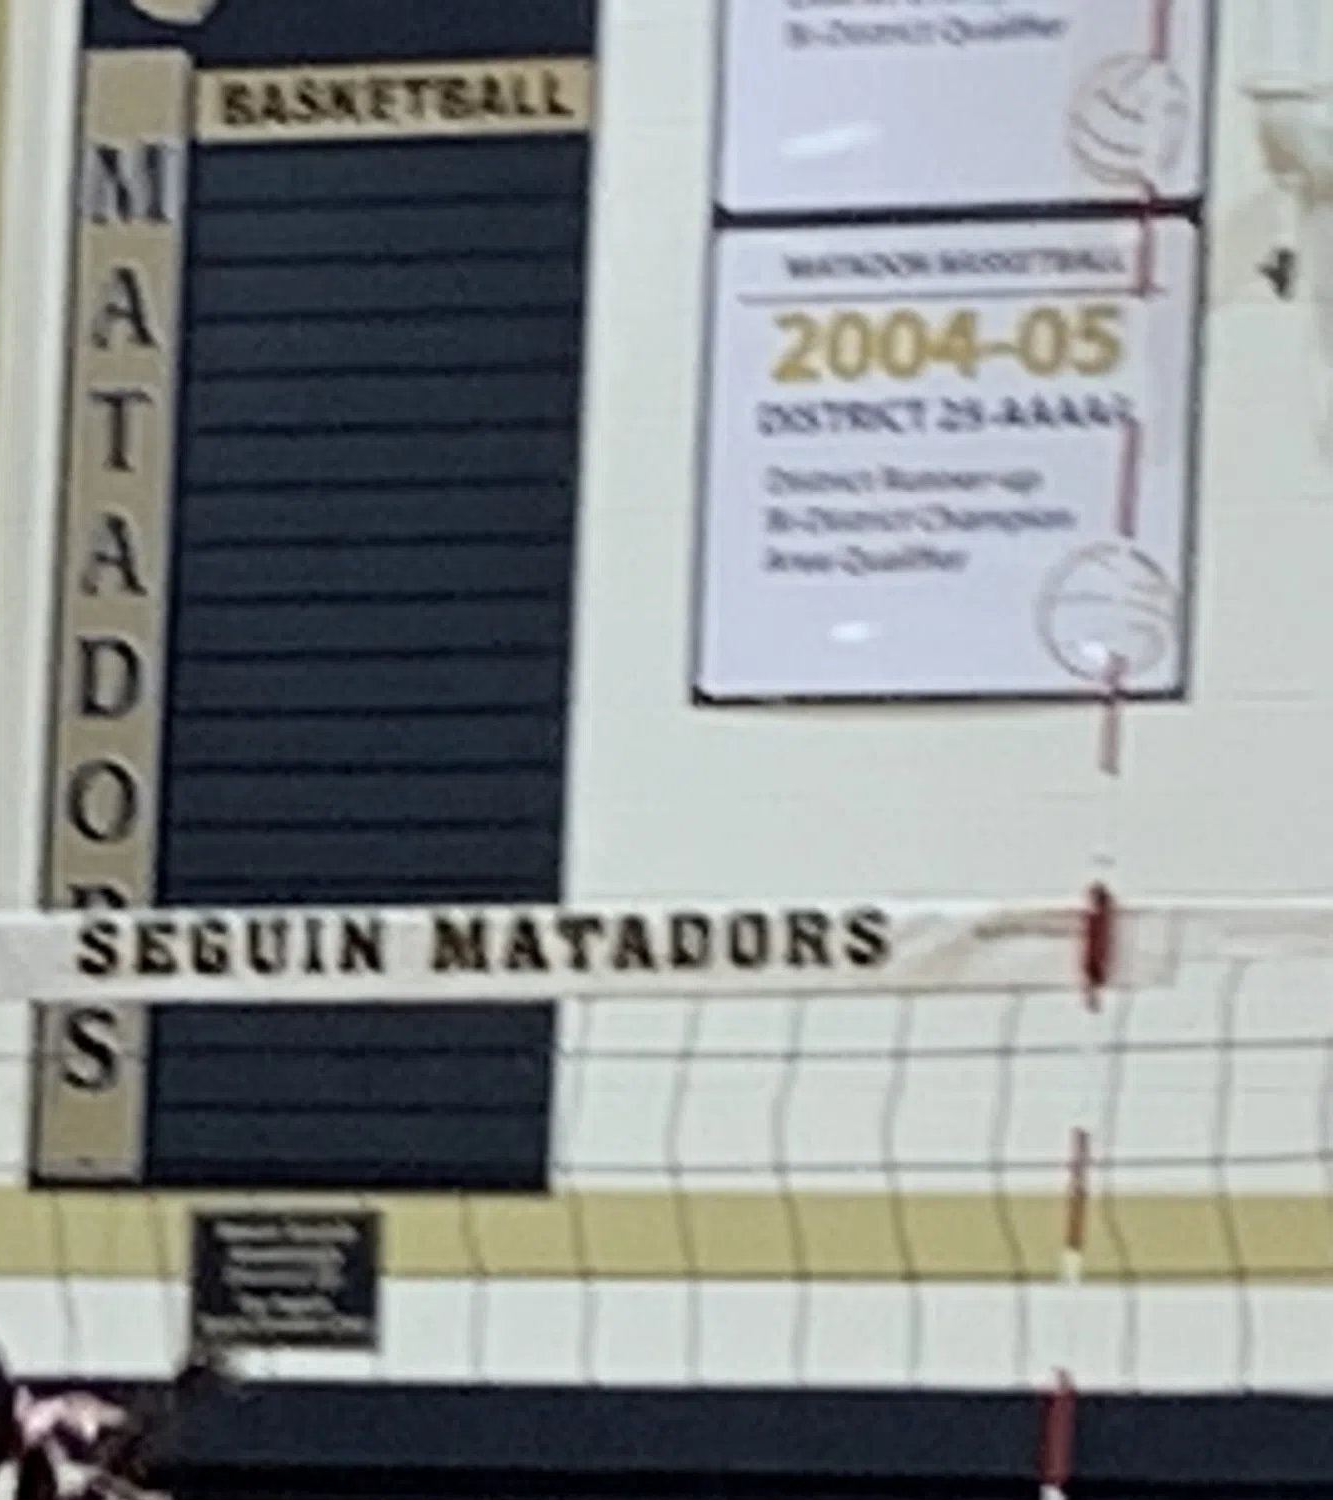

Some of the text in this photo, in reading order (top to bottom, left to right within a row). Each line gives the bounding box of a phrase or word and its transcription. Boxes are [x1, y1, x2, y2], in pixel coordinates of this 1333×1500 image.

[219, 71, 575, 126] BASKETBALL
[770, 305, 1123, 385] 2004-05
[756, 398, 927, 436] DISTRICT
[60, 143, 174, 1091] MATADOS
[76, 918, 387, 976] SEGUIN
[431, 906, 891, 974] MATADORS
